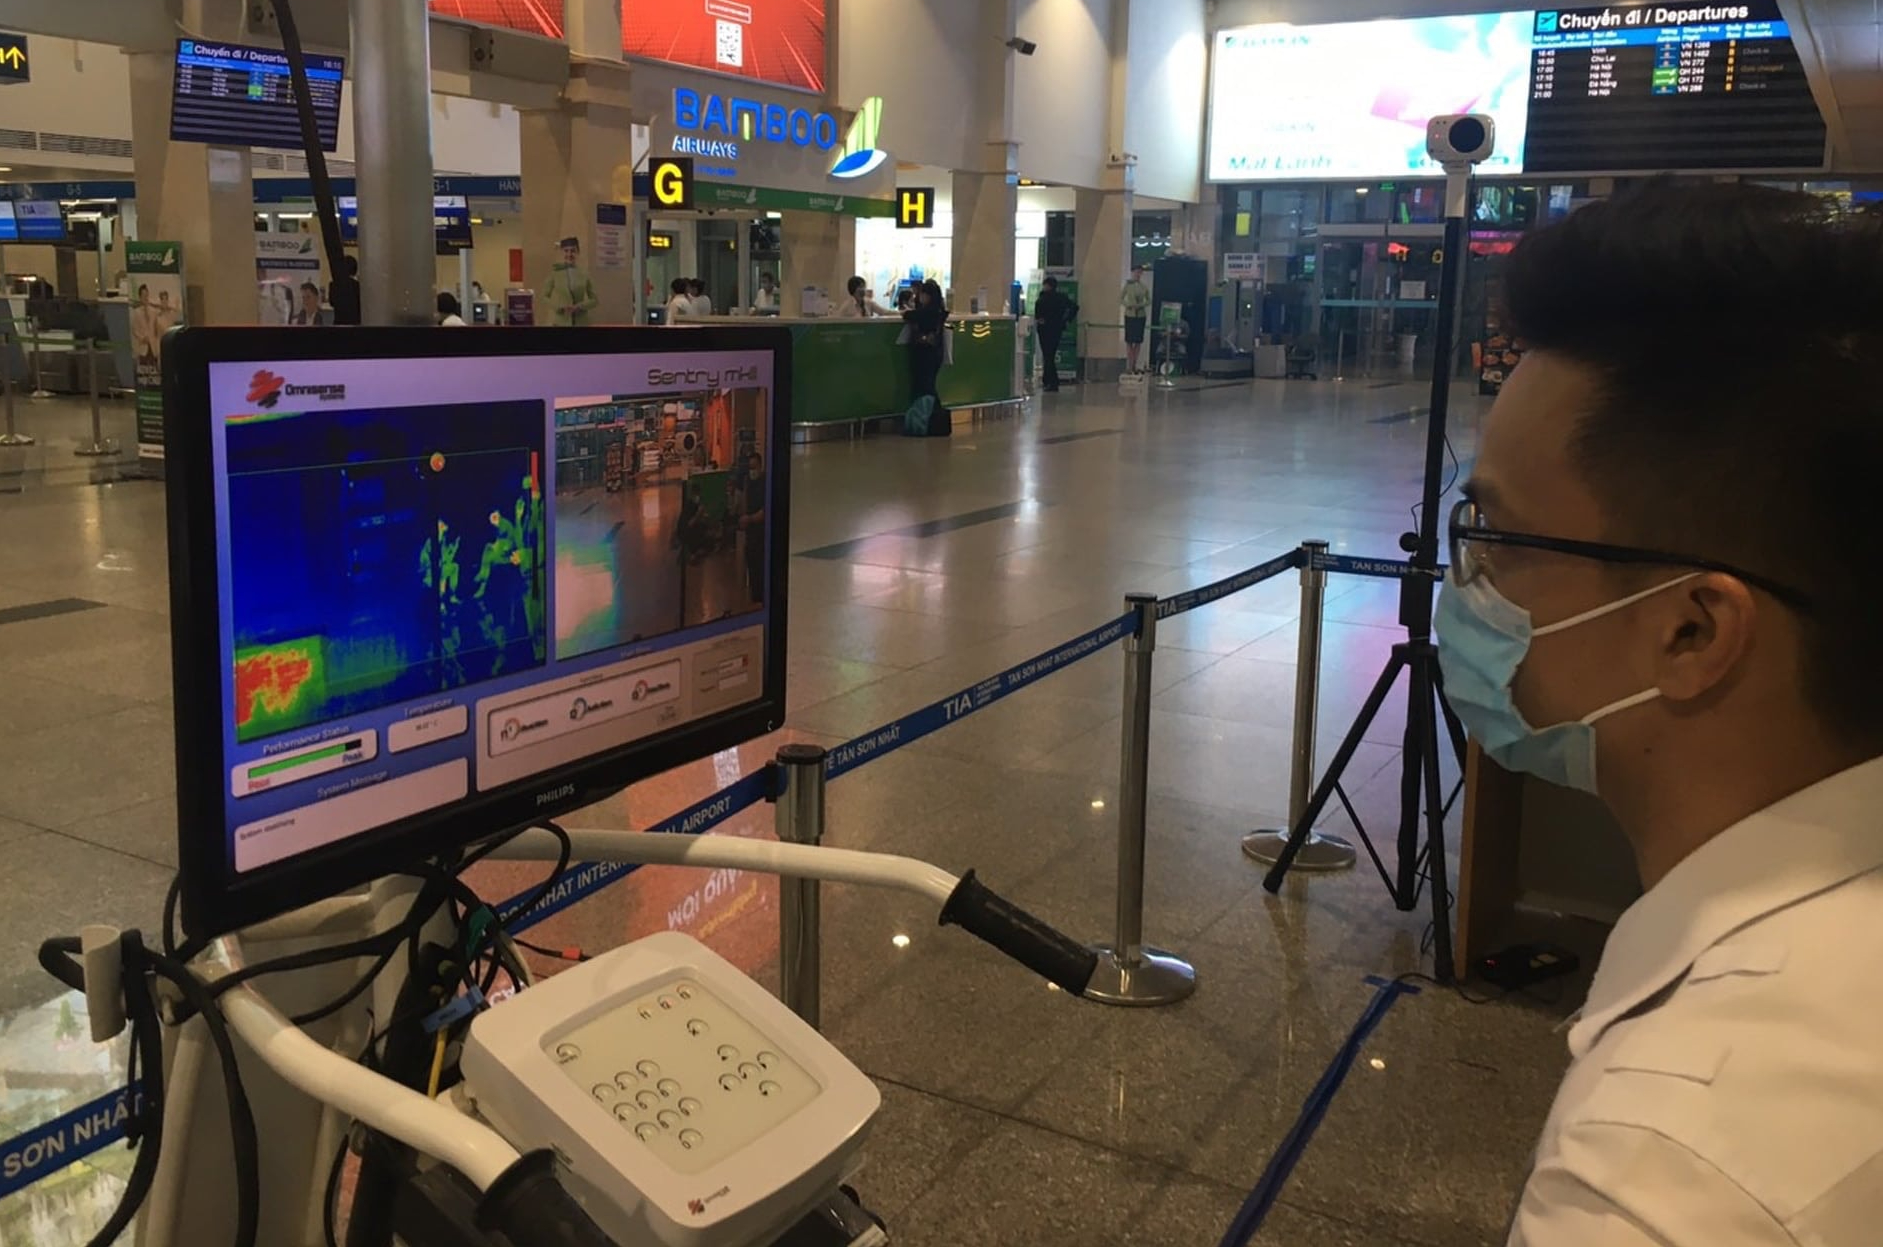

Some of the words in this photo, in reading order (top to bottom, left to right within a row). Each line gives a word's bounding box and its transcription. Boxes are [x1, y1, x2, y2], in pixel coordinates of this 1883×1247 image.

[1559, 9, 1621, 30] Chuyến
[1625, 10, 1641, 25] đi
[1644, 9, 1652, 24] /
[1655, 6, 1749, 25] Departures
[672, 87, 838, 152] BAMBOO
[672, 134, 739, 161] AIRWAYS
[653, 162, 684, 205] G
[902, 191, 925, 225] H
[647, 368, 720, 388] Sentry
[1156, 598, 1178, 618] TIA
[943, 693, 973, 721] TIA
[263, 731, 321, 755] Performance
[322, 725, 351, 743] Status
[836, 747, 856, 767] TÂN
[877, 722, 901, 748] NHẤT
[341, 751, 365, 764] Peak
[317, 779, 350, 799] System
[349, 769, 389, 789] Message
[536, 783, 576, 807] PHILIPS
[681, 795, 732, 832] AIRPORT
[3, 1129, 66, 1178] SƠN
